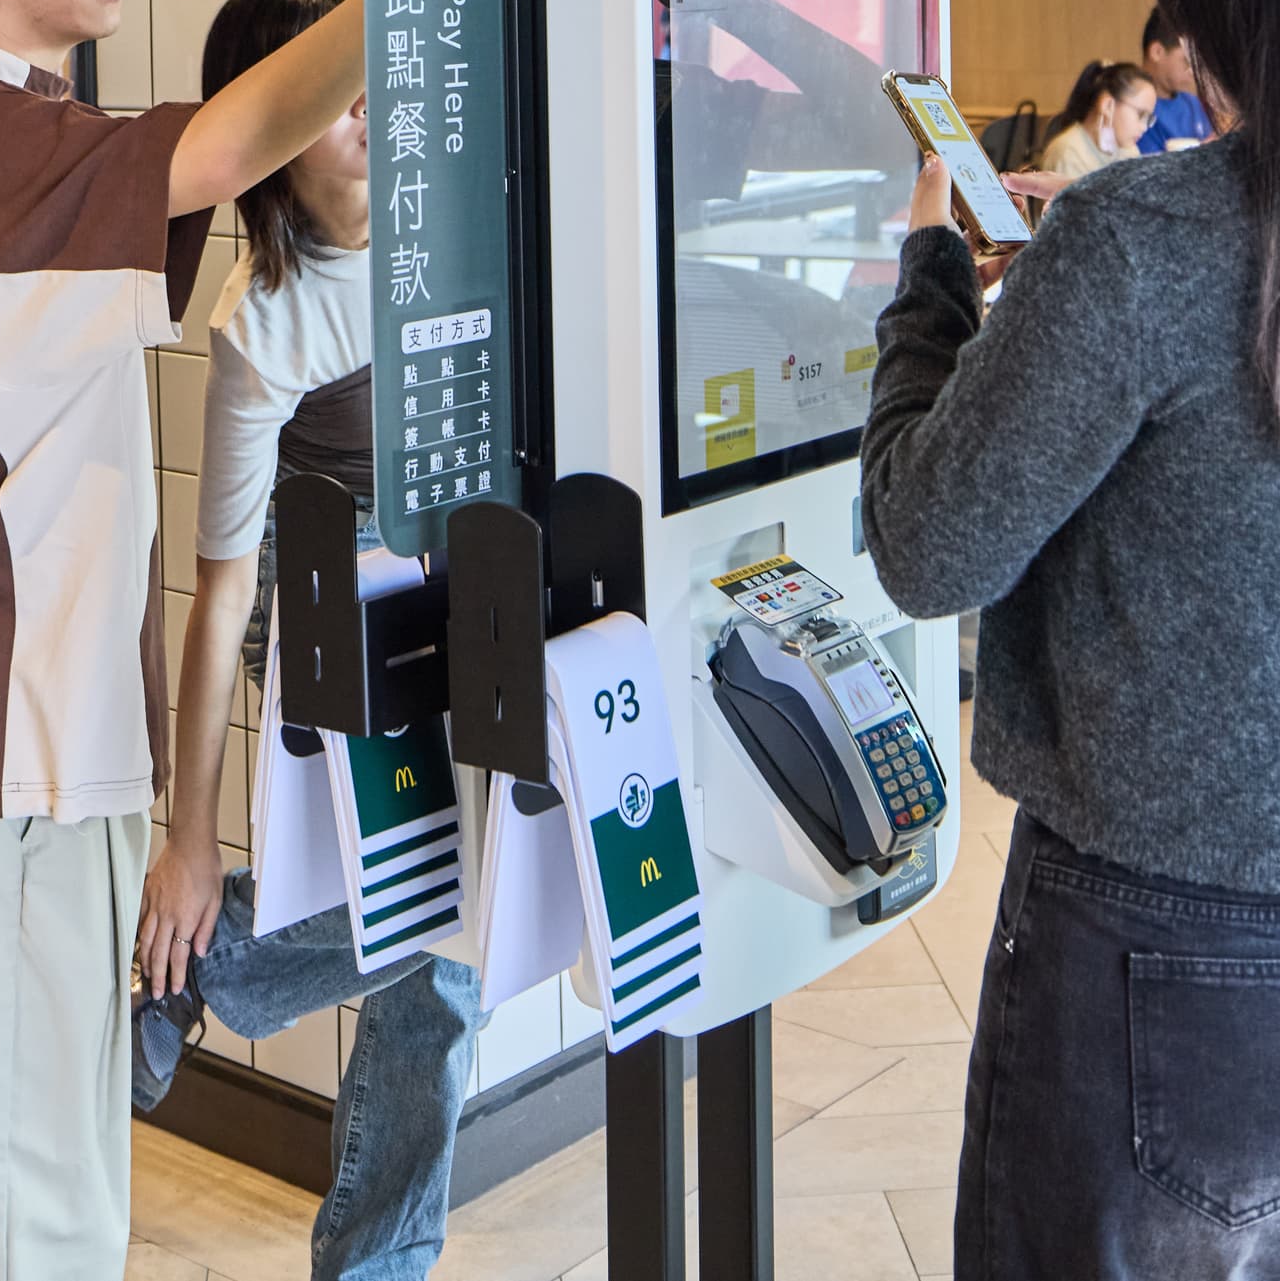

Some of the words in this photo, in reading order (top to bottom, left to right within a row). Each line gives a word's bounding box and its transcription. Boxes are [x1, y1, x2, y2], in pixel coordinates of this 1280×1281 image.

[443, 64, 469, 154] Here
[407, 315, 487, 348] 支付方式
[403, 349, 491, 387] 點點卡
[798, 362, 823, 382] $157
[403, 379, 491, 418] 信用卡
[403, 409, 491, 449] 簽帳卡
[404, 440, 492, 480] 行動支付
[405, 470, 492, 511] 電子票證
[593, 678, 641, 735] 93
